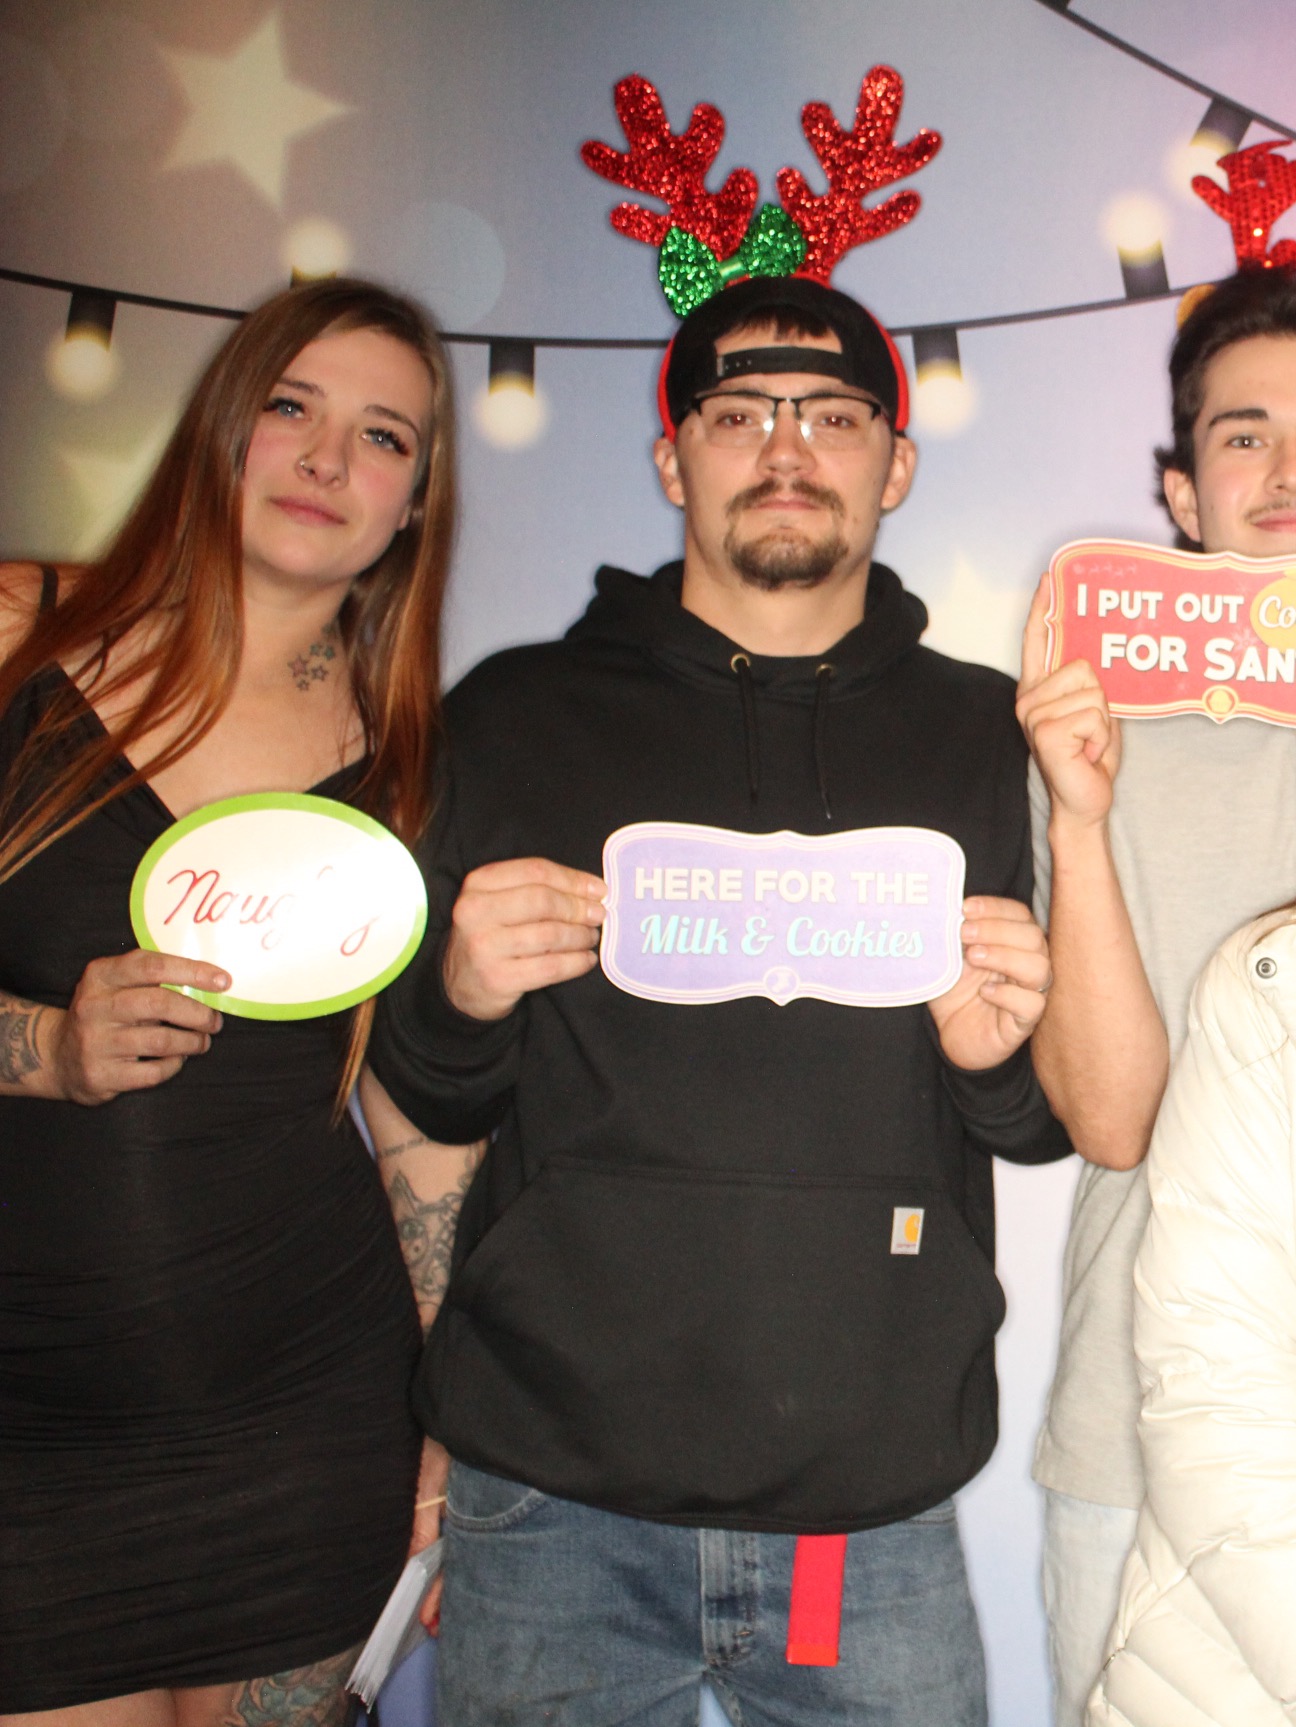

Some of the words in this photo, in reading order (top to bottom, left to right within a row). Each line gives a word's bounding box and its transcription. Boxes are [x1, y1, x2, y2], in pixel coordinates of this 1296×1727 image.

[1076, 583, 1088, 616] I
[1097, 588, 1163, 620] PUT
[1174, 592, 1244, 624] OUT
[1100, 633, 1189, 673] FOR
[634, 866, 743, 902] HERE
[754, 869, 836, 903] FOR
[850, 871, 929, 904] THE
[639, 914, 729, 955] Milk
[740, 916, 775, 956] &
[786, 916, 925, 958] Cookies
